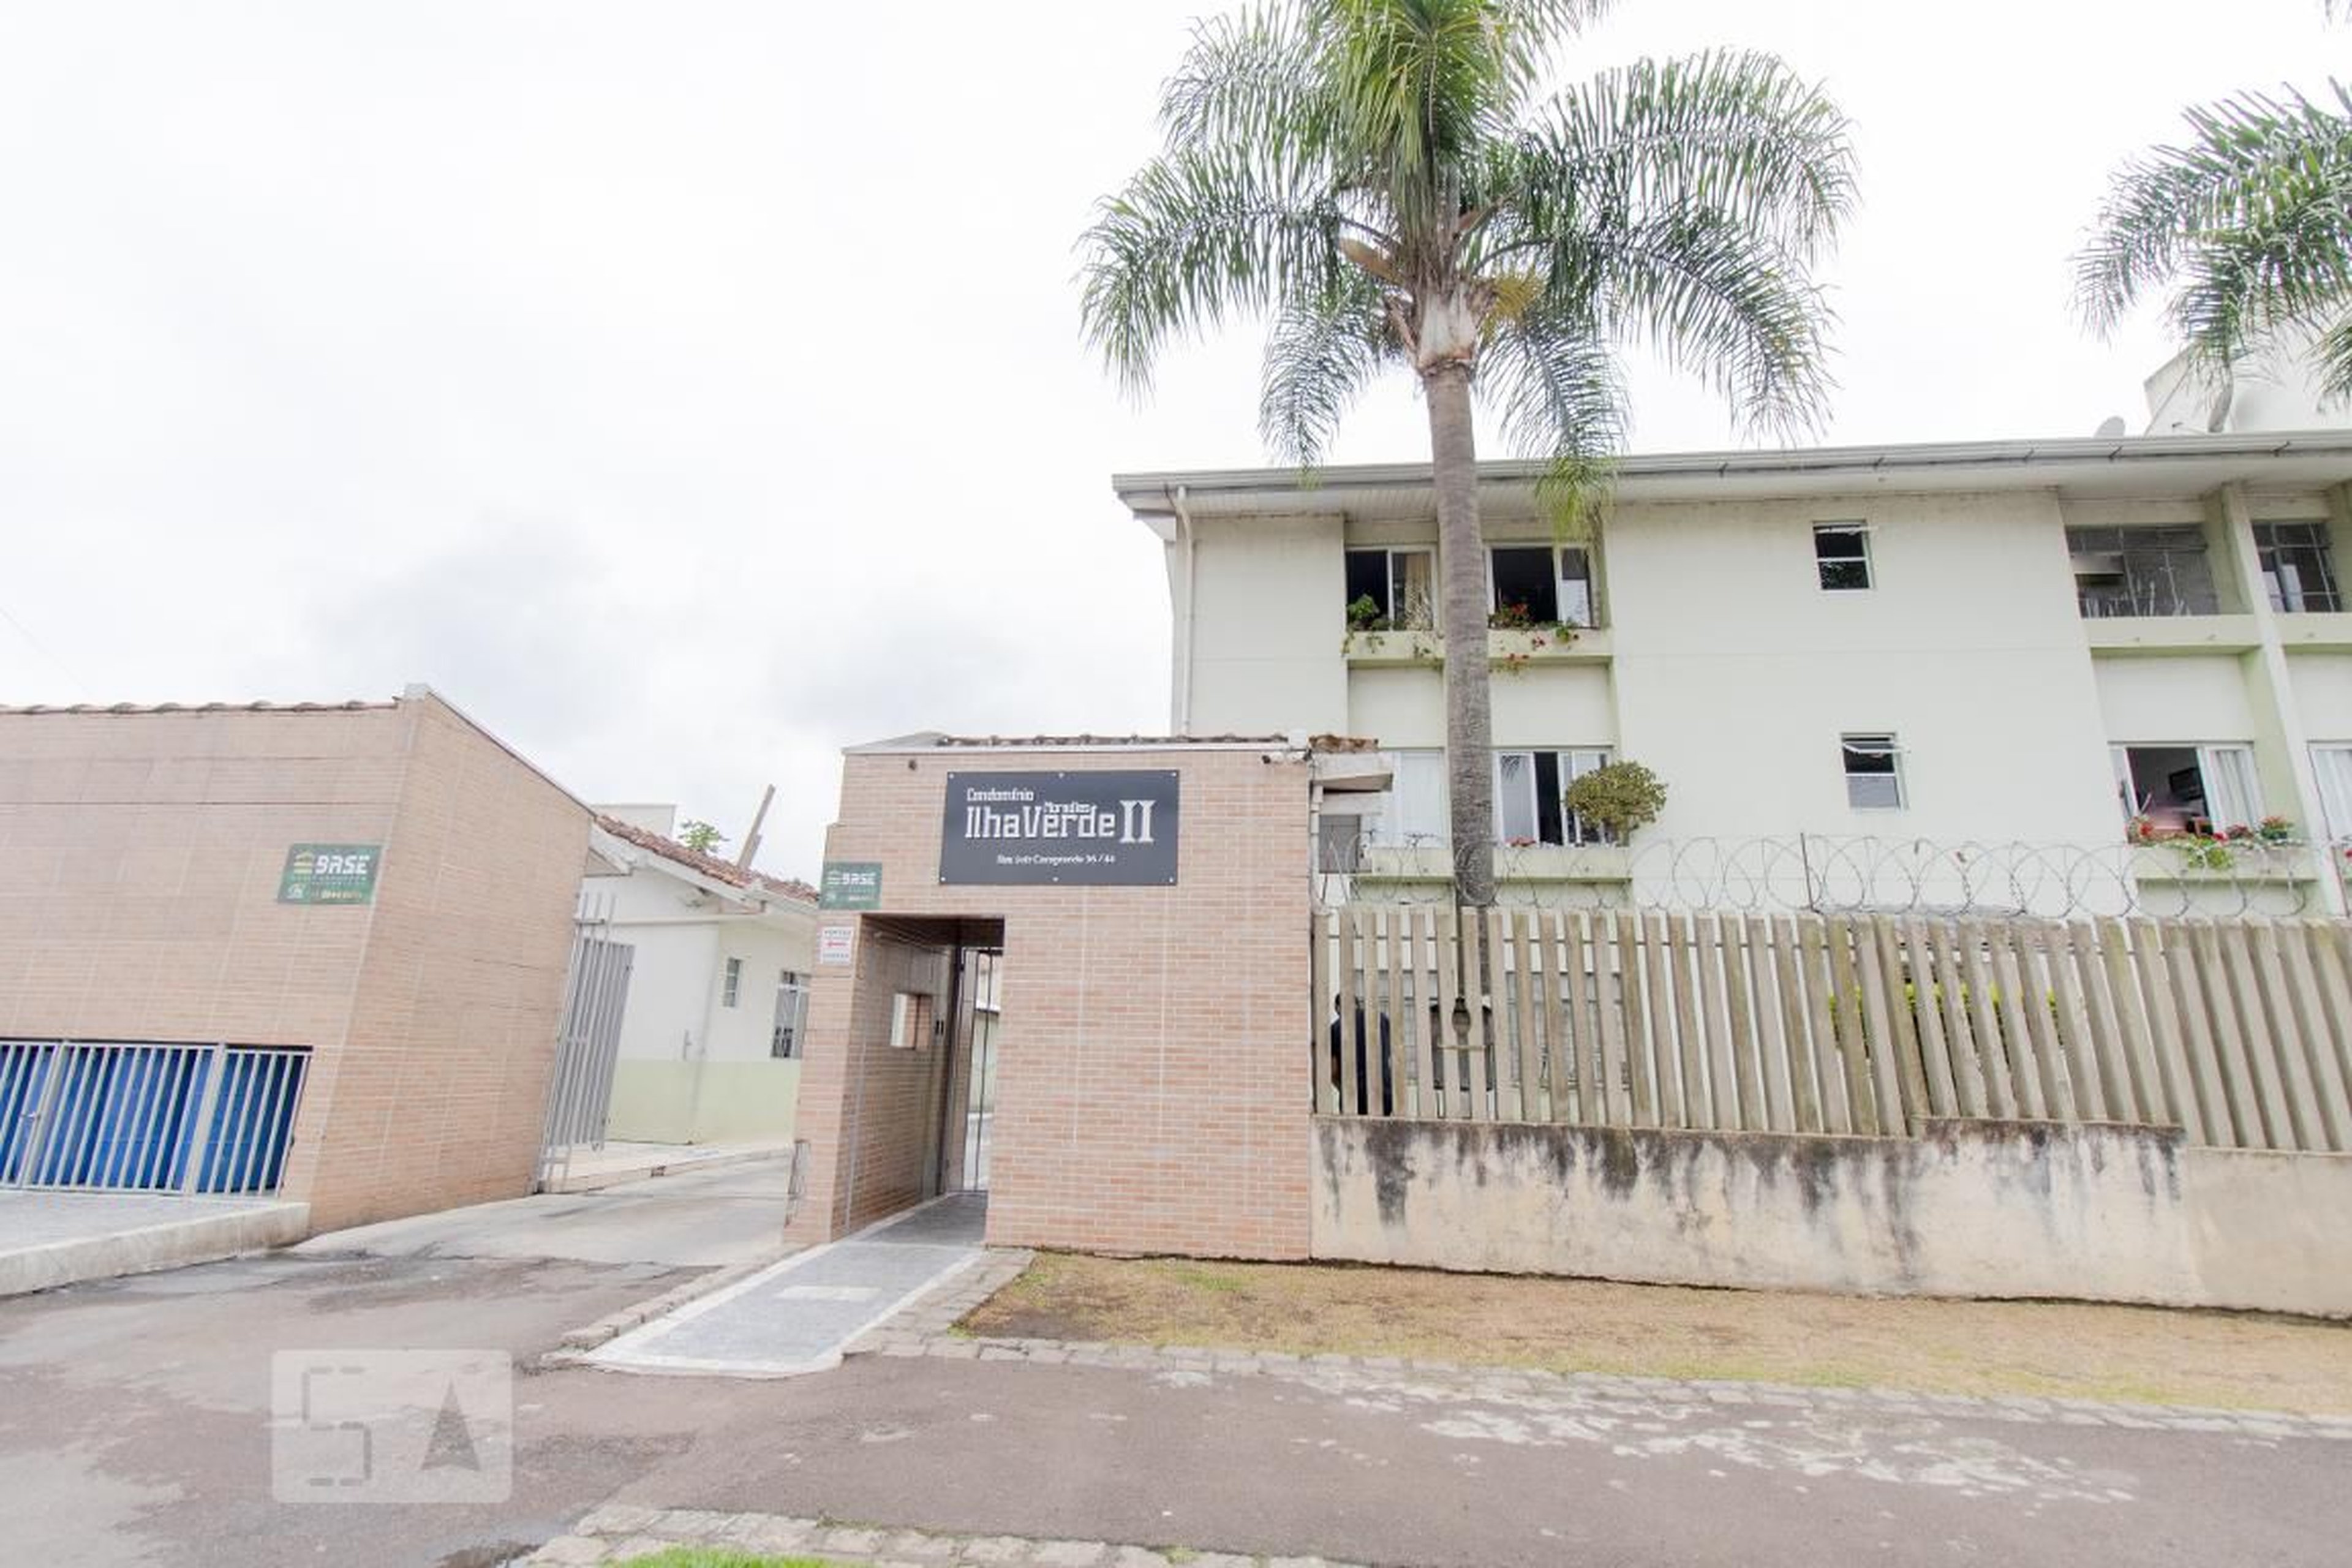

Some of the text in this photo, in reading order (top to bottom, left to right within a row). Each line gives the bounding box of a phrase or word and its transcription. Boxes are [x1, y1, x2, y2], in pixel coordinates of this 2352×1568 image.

[967, 787, 1035, 802] Condomínio
[1119, 799, 1156, 843] II
[315, 854, 370, 874] BASE
